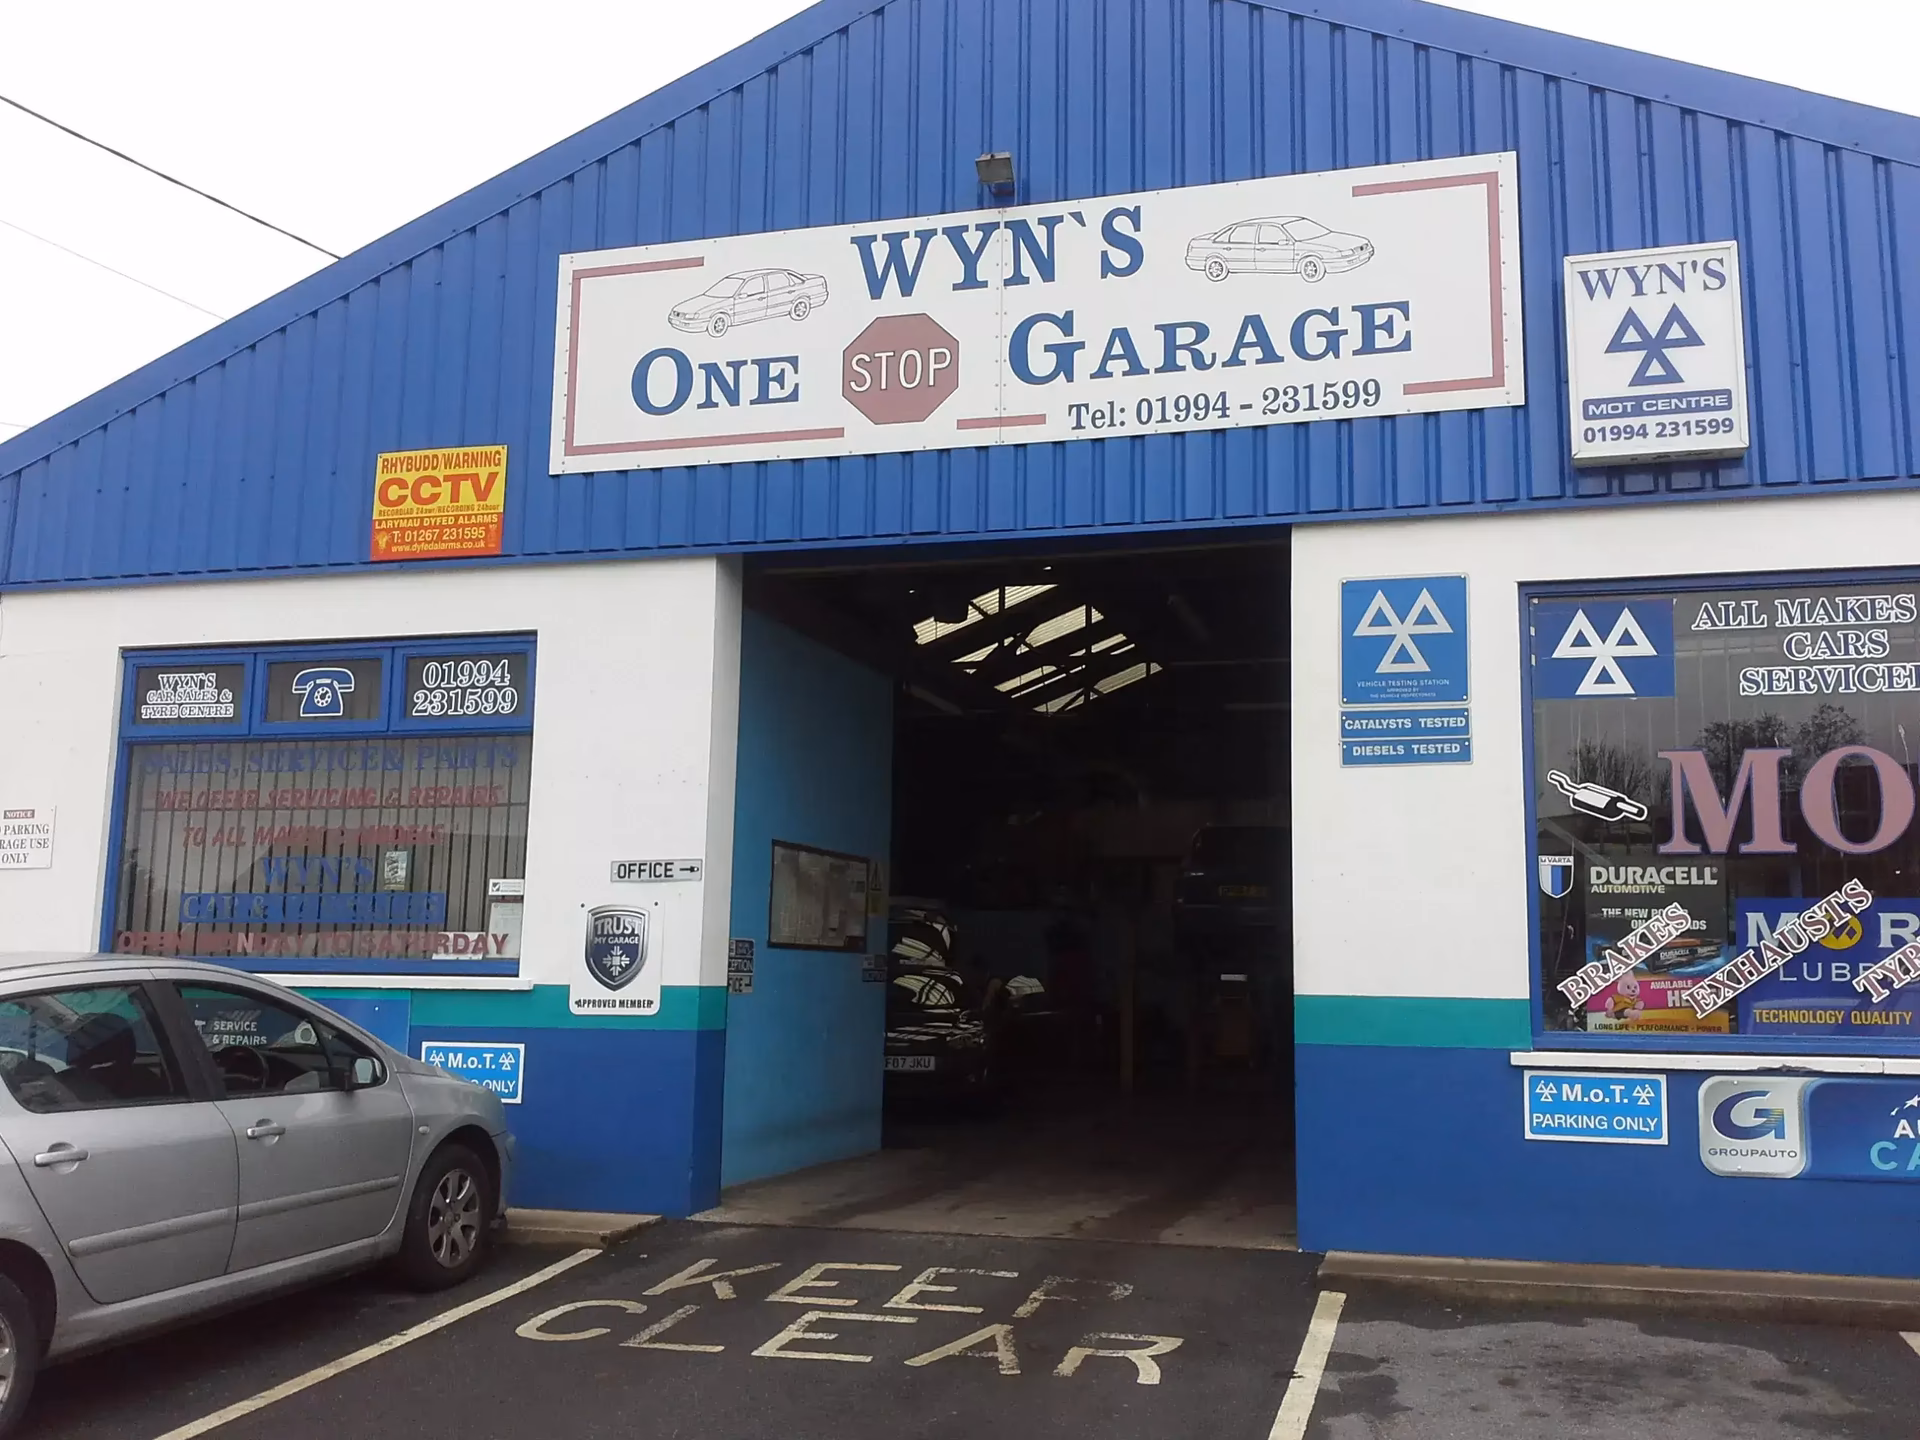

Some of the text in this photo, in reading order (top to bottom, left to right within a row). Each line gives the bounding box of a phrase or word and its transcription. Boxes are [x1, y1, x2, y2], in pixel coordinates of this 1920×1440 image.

[1577, 257, 1727, 301] WYN'S
[631, 300, 1412, 415] ONE STOP GARAGE
[1068, 403, 1126, 431] Tel:
[1136, 390, 1231, 426] 01994
[1262, 378, 1382, 417] 231599
[1588, 394, 1729, 416] MOT CENTRE
[1583, 418, 1734, 443] 01994 231599
[378, 471, 500, 508] CCTV
[375, 514, 499, 530] LARYMAU DYFED ALARMS
[392, 526, 486, 543] T: 01267 231595
[391, 539, 486, 554] www.dyfedalarms.co.uk
[1691, 594, 1918, 630] ALL MAKES
[1783, 629, 1890, 661] CARS
[422, 659, 511, 690] 01994
[1357, 680, 1387, 688] VEHICLE
[1420, 678, 1450, 686] STATION
[1739, 663, 1920, 696] SERVICE
[147, 688, 233, 704] CAR SALES &
[412, 686, 519, 717] 231599
[141, 703, 234, 718] TYRE CENTRE
[1344, 716, 1466, 730] CATALYSTS TESTED
[415, 744, 520, 771] PARTS
[1352, 743, 1461, 756] DIESELS TESTED
[407, 784, 504, 807] REPAIRS
[1657, 745, 1920, 855] MO
[6, 810, 33, 818] NOTICE
[4, 823, 50, 836] PARKING
[211, 826, 247, 847] ALL
[30, 838, 50, 849] USE
[1, 852, 29, 864] ONLY
[617, 861, 675, 879] OFFICE
[1590, 885, 1666, 894] AUTOMOTIVE
[1602, 908, 1622, 917] THE
[1625, 908, 1649, 918] NEW
[595, 916, 642, 937] TRUST
[607, 936, 639, 945] GARAGE
[1682, 877, 1874, 1020] EXHAUSTS
[1556, 902, 1692, 1009] BRAKES
[1650, 979, 1693, 990] AVAILABLE
[577, 998, 653, 1009] APPROVED MEMBER
[213, 1020, 258, 1032] SERVICE
[1753, 1009, 1913, 1025] TECHNOLOGY QUALITY
[1594, 1023, 1613, 1031] LONG
[1614, 1023, 1629, 1031] LIFE
[1636, 1023, 1690, 1032] PERFORMANCE
[1696, 1025, 1723, 1033] POWER
[212, 1034, 268, 1046] & REPAIRS
[448, 1052, 496, 1070] M.o.T.
[1561, 1085, 1629, 1104] M.o.T.
[1532, 1113, 1659, 1133] PARKING ONLY
[1708, 1147, 1798, 1159] GROUPAUTO
[515, 1300, 1185, 1386] CLEAR
